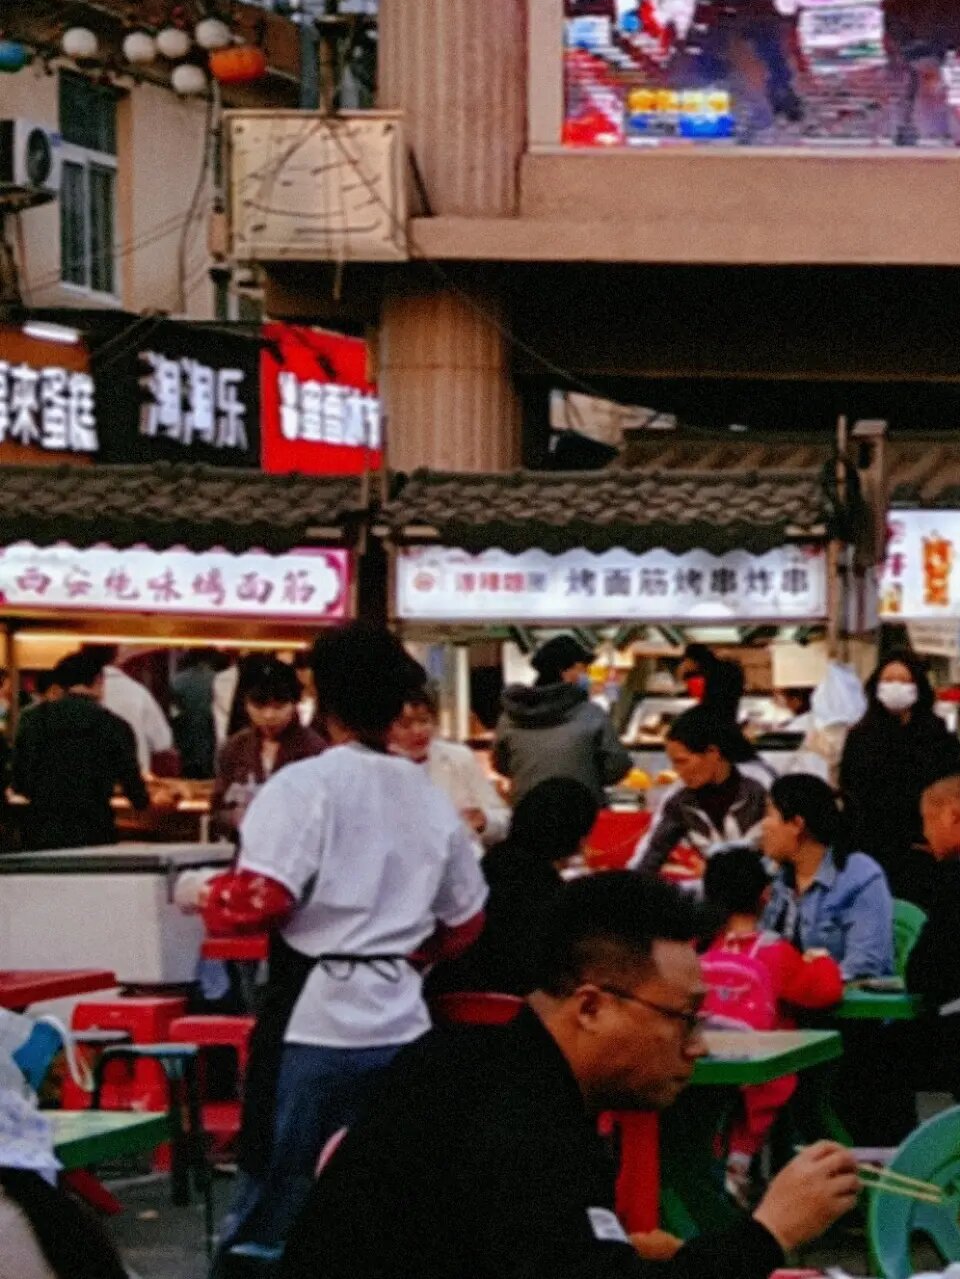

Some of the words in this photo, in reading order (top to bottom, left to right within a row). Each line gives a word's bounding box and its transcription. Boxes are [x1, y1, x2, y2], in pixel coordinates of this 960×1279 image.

[564, 567, 810, 598] 烤面筋烤串炸串
